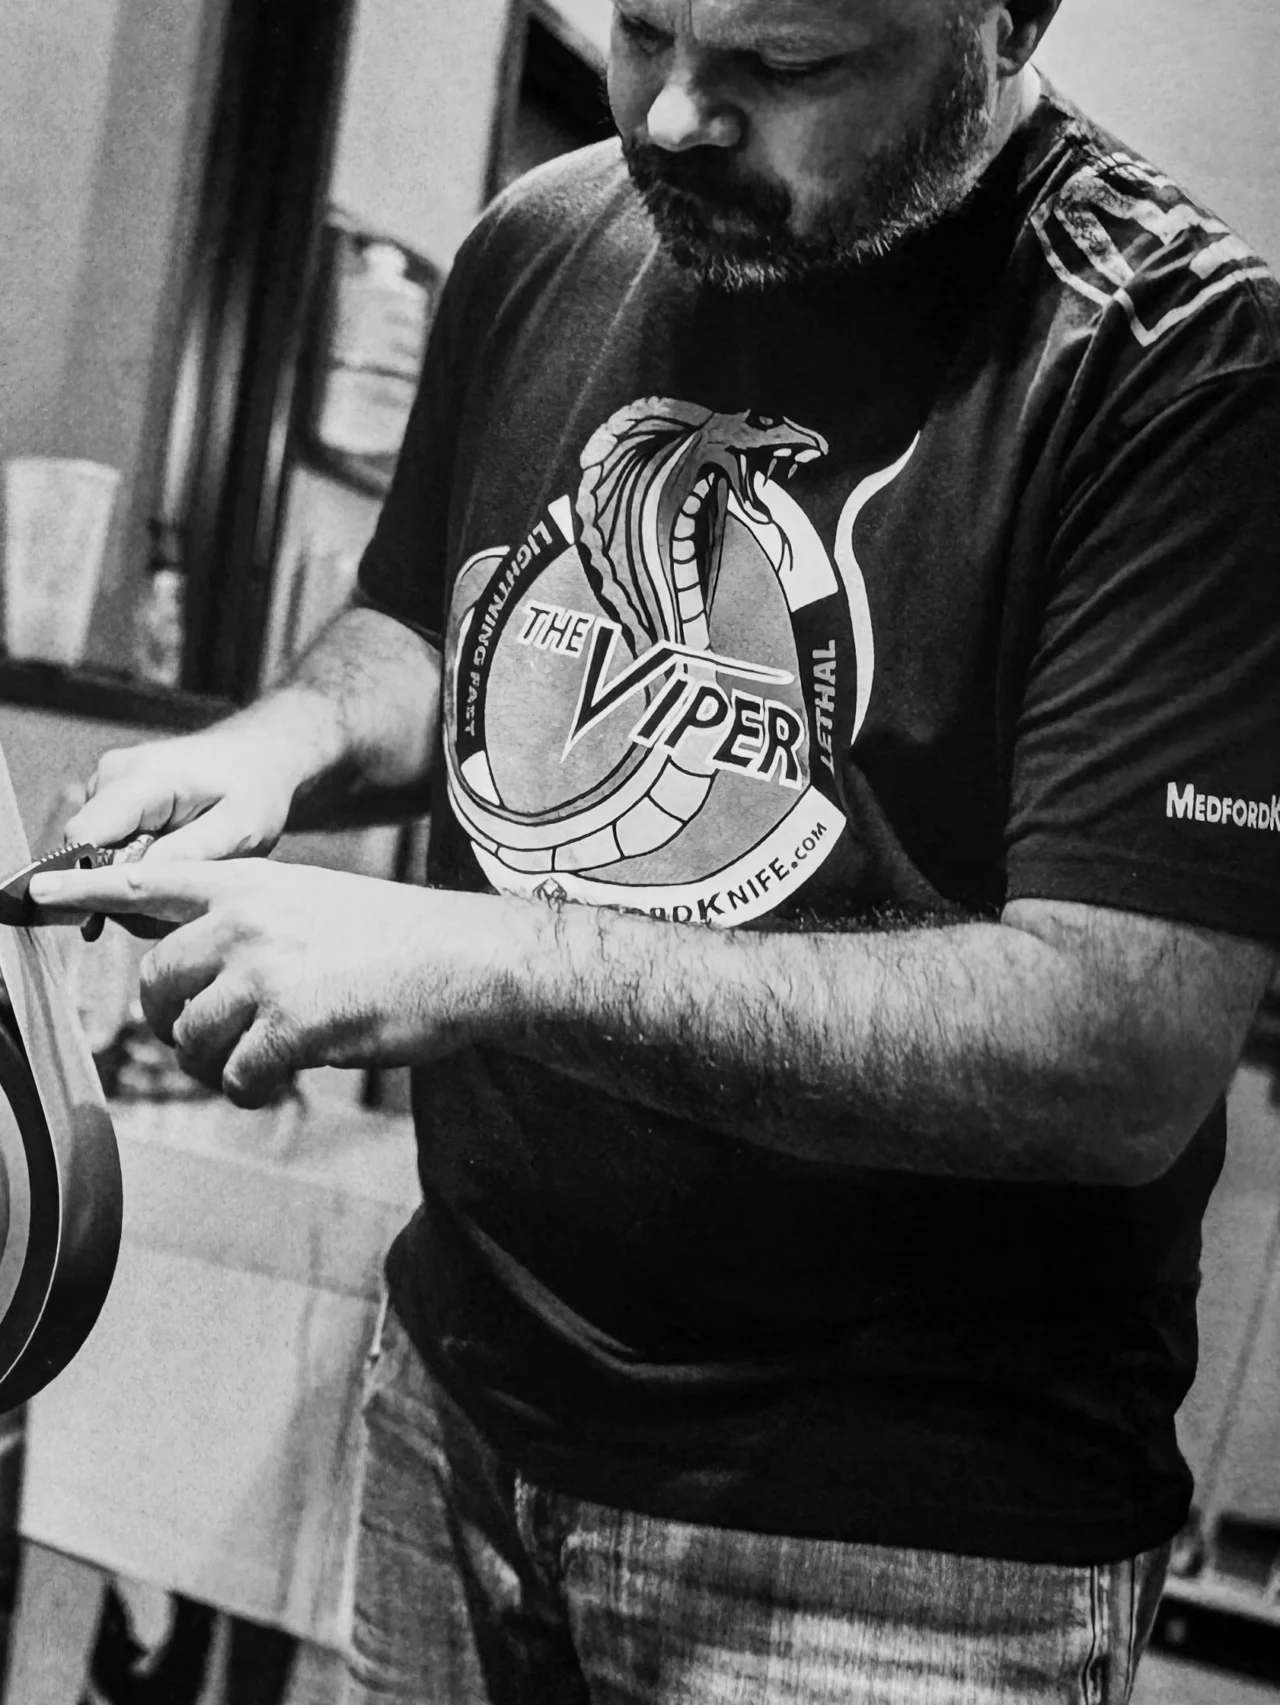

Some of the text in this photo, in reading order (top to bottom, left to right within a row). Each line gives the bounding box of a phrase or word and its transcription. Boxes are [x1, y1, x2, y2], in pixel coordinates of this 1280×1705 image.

[473, 520, 553, 667] LIGHTNING
[518, 600, 596, 659] THE
[560, 616, 805, 791] VIPER
[812, 639, 837, 779] LETHAL
